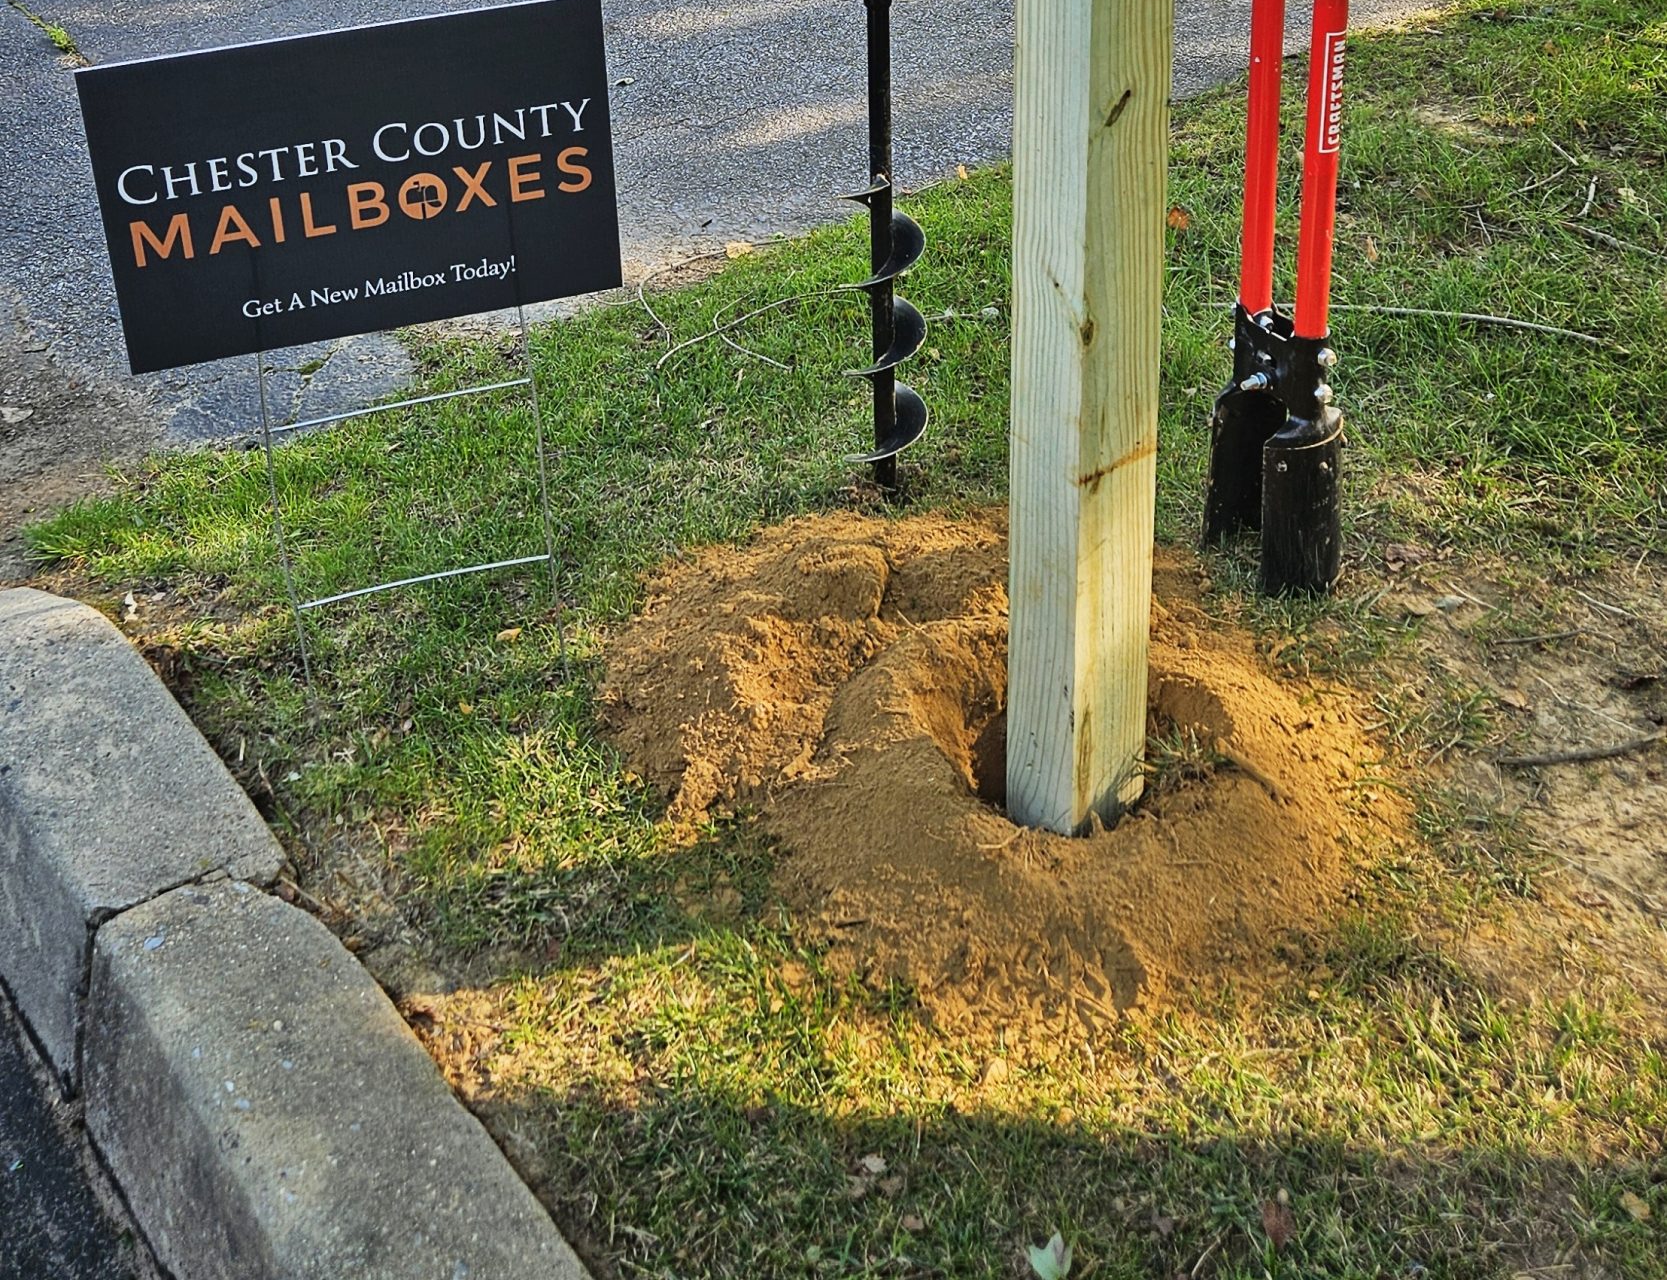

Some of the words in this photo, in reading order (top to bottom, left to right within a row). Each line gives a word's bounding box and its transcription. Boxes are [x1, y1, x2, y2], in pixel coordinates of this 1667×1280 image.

[1327, 39, 1346, 145] CRAFTSMAN
[117, 138, 359, 205] CHESTER
[372, 97, 592, 162] COUNTY
[129, 145, 593, 268] MAILBOXES
[241, 297, 284, 319] Get
[287, 292, 306, 312] A
[310, 286, 359, 308] New
[363, 271, 447, 299] Mailbox
[449, 254, 517, 282] Today!
